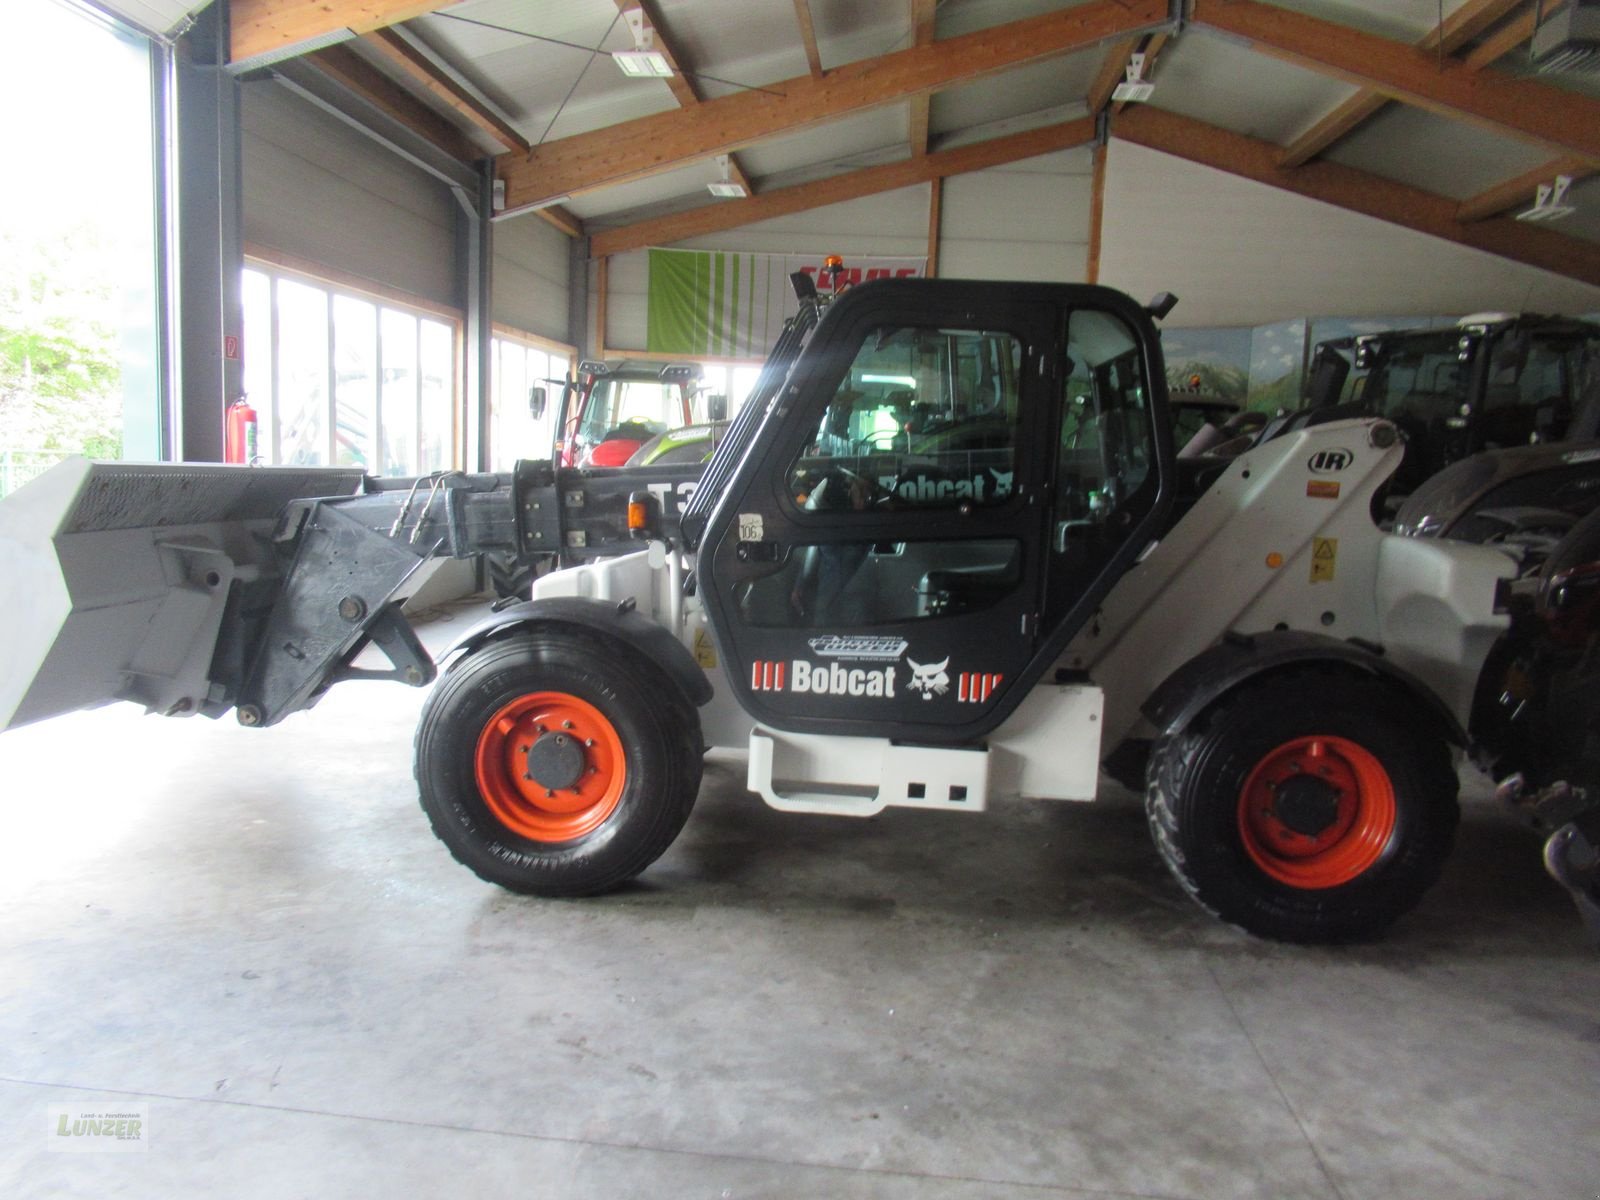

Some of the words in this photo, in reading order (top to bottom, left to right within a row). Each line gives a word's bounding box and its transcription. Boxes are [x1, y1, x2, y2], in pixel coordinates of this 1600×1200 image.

[1315, 452, 1345, 470] IR
[740, 525, 757, 540] 106
[791, 660, 896, 698] Bobcat
